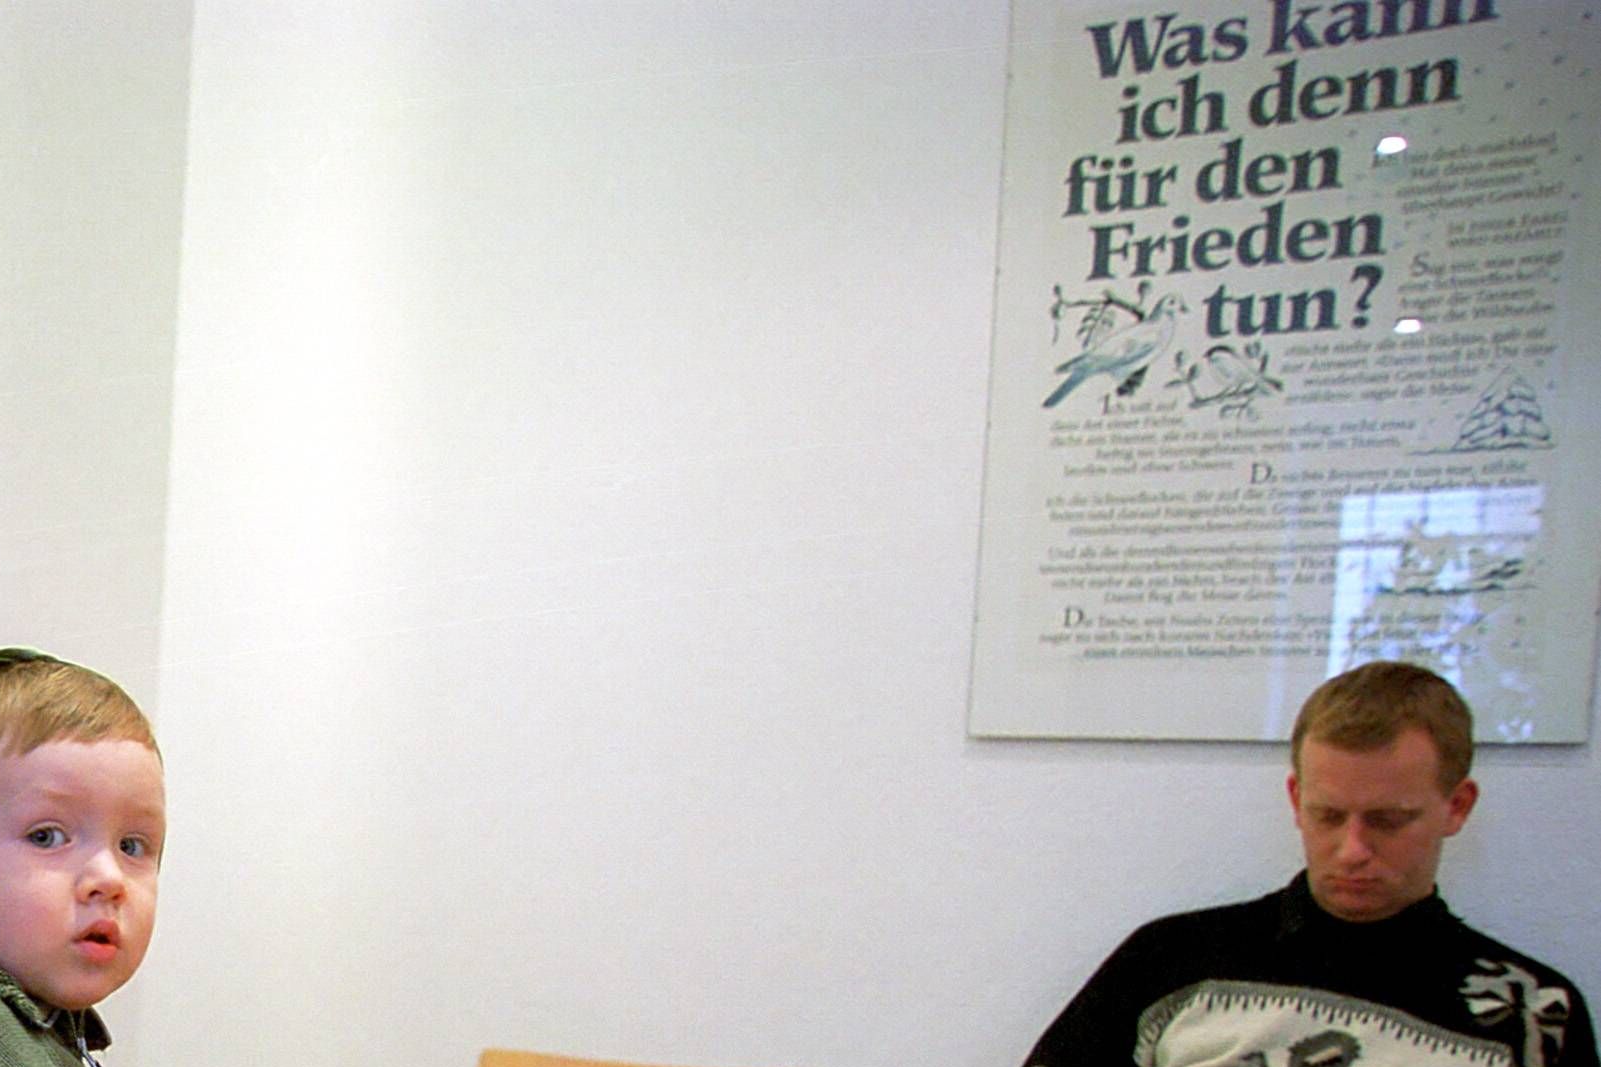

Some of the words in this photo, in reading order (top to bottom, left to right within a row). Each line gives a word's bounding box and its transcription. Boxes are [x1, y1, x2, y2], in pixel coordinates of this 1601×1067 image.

[1086, 14, 1249, 79] Was
[1116, 73, 1226, 144] ich
[1247, 56, 1462, 127] denn
[1062, 154, 1179, 217] für
[1195, 136, 1342, 203] den
[1087, 200, 1387, 281] Frieden
[1202, 264, 1386, 338] tun?
